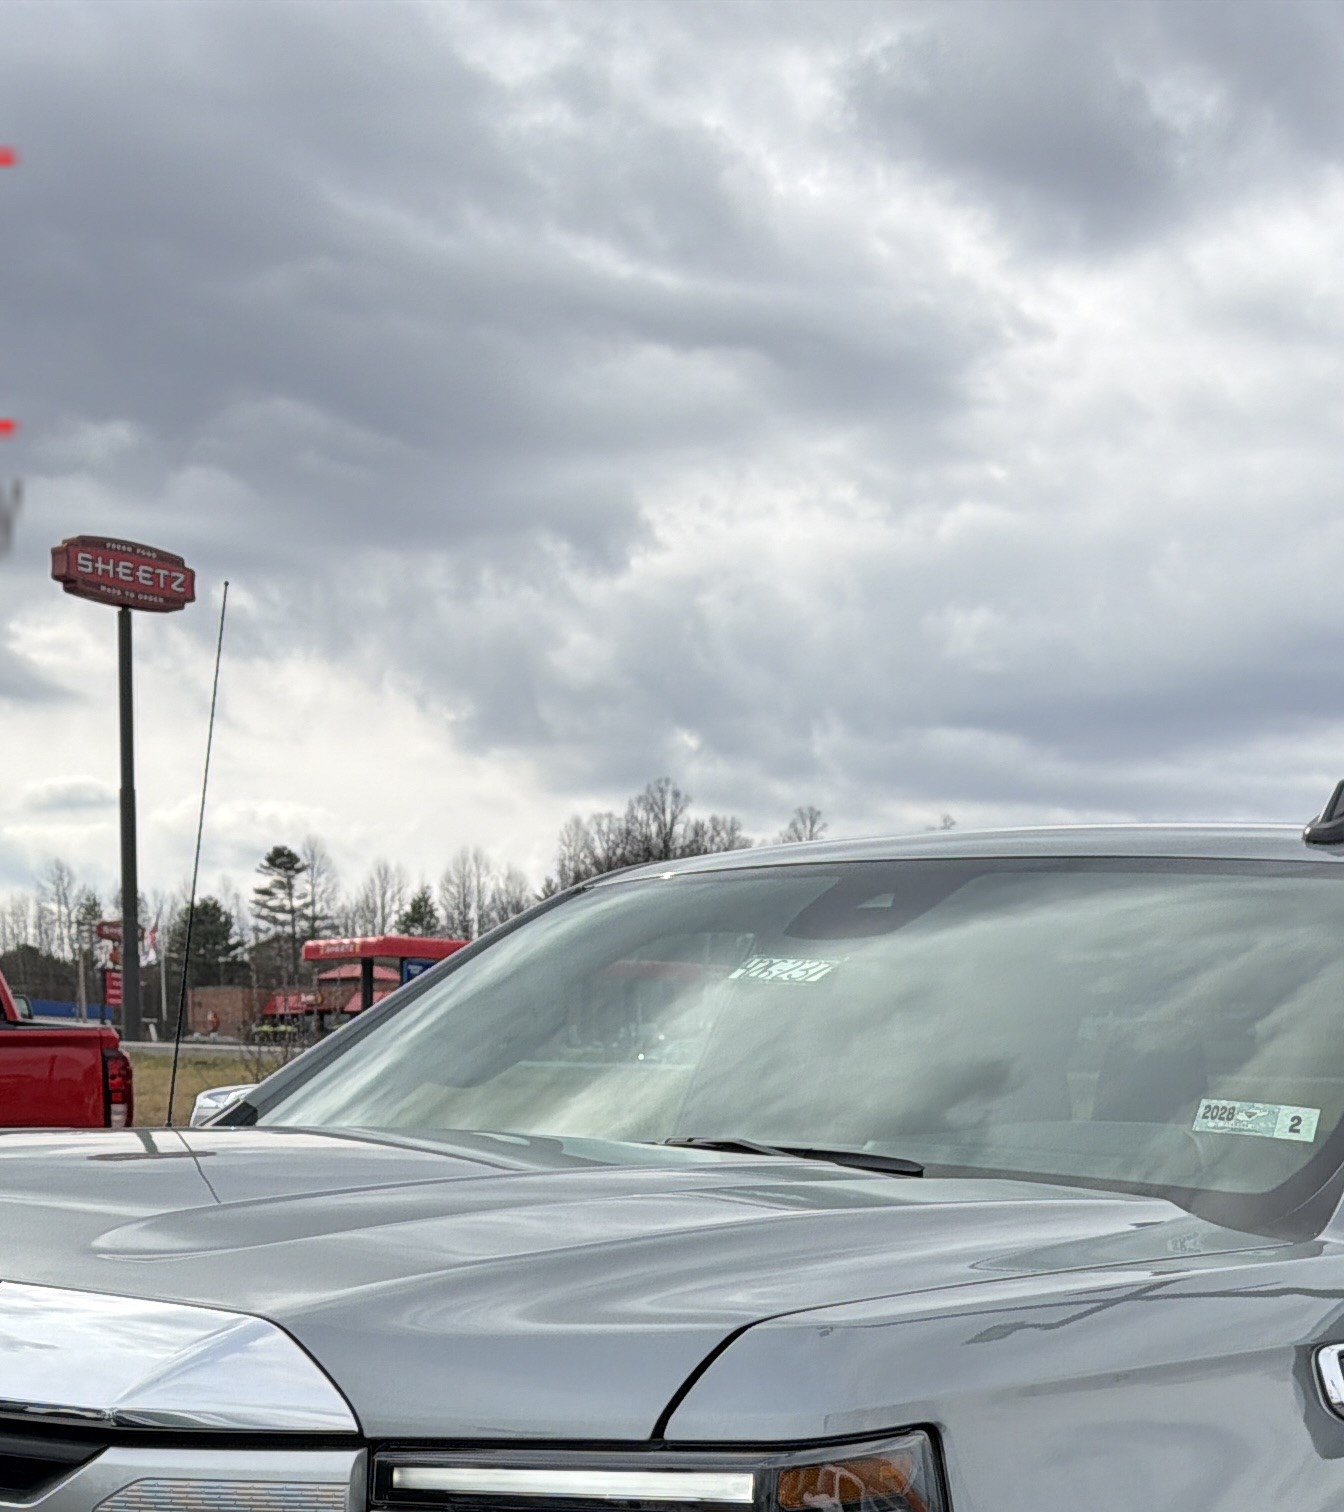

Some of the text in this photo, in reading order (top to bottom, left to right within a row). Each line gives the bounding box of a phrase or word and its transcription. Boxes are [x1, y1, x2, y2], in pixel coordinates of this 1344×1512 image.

[77, 552, 186, 593] SHEETZ
[1201, 1104, 1236, 1122] 2028
[1288, 1115, 1303, 1134] 2
